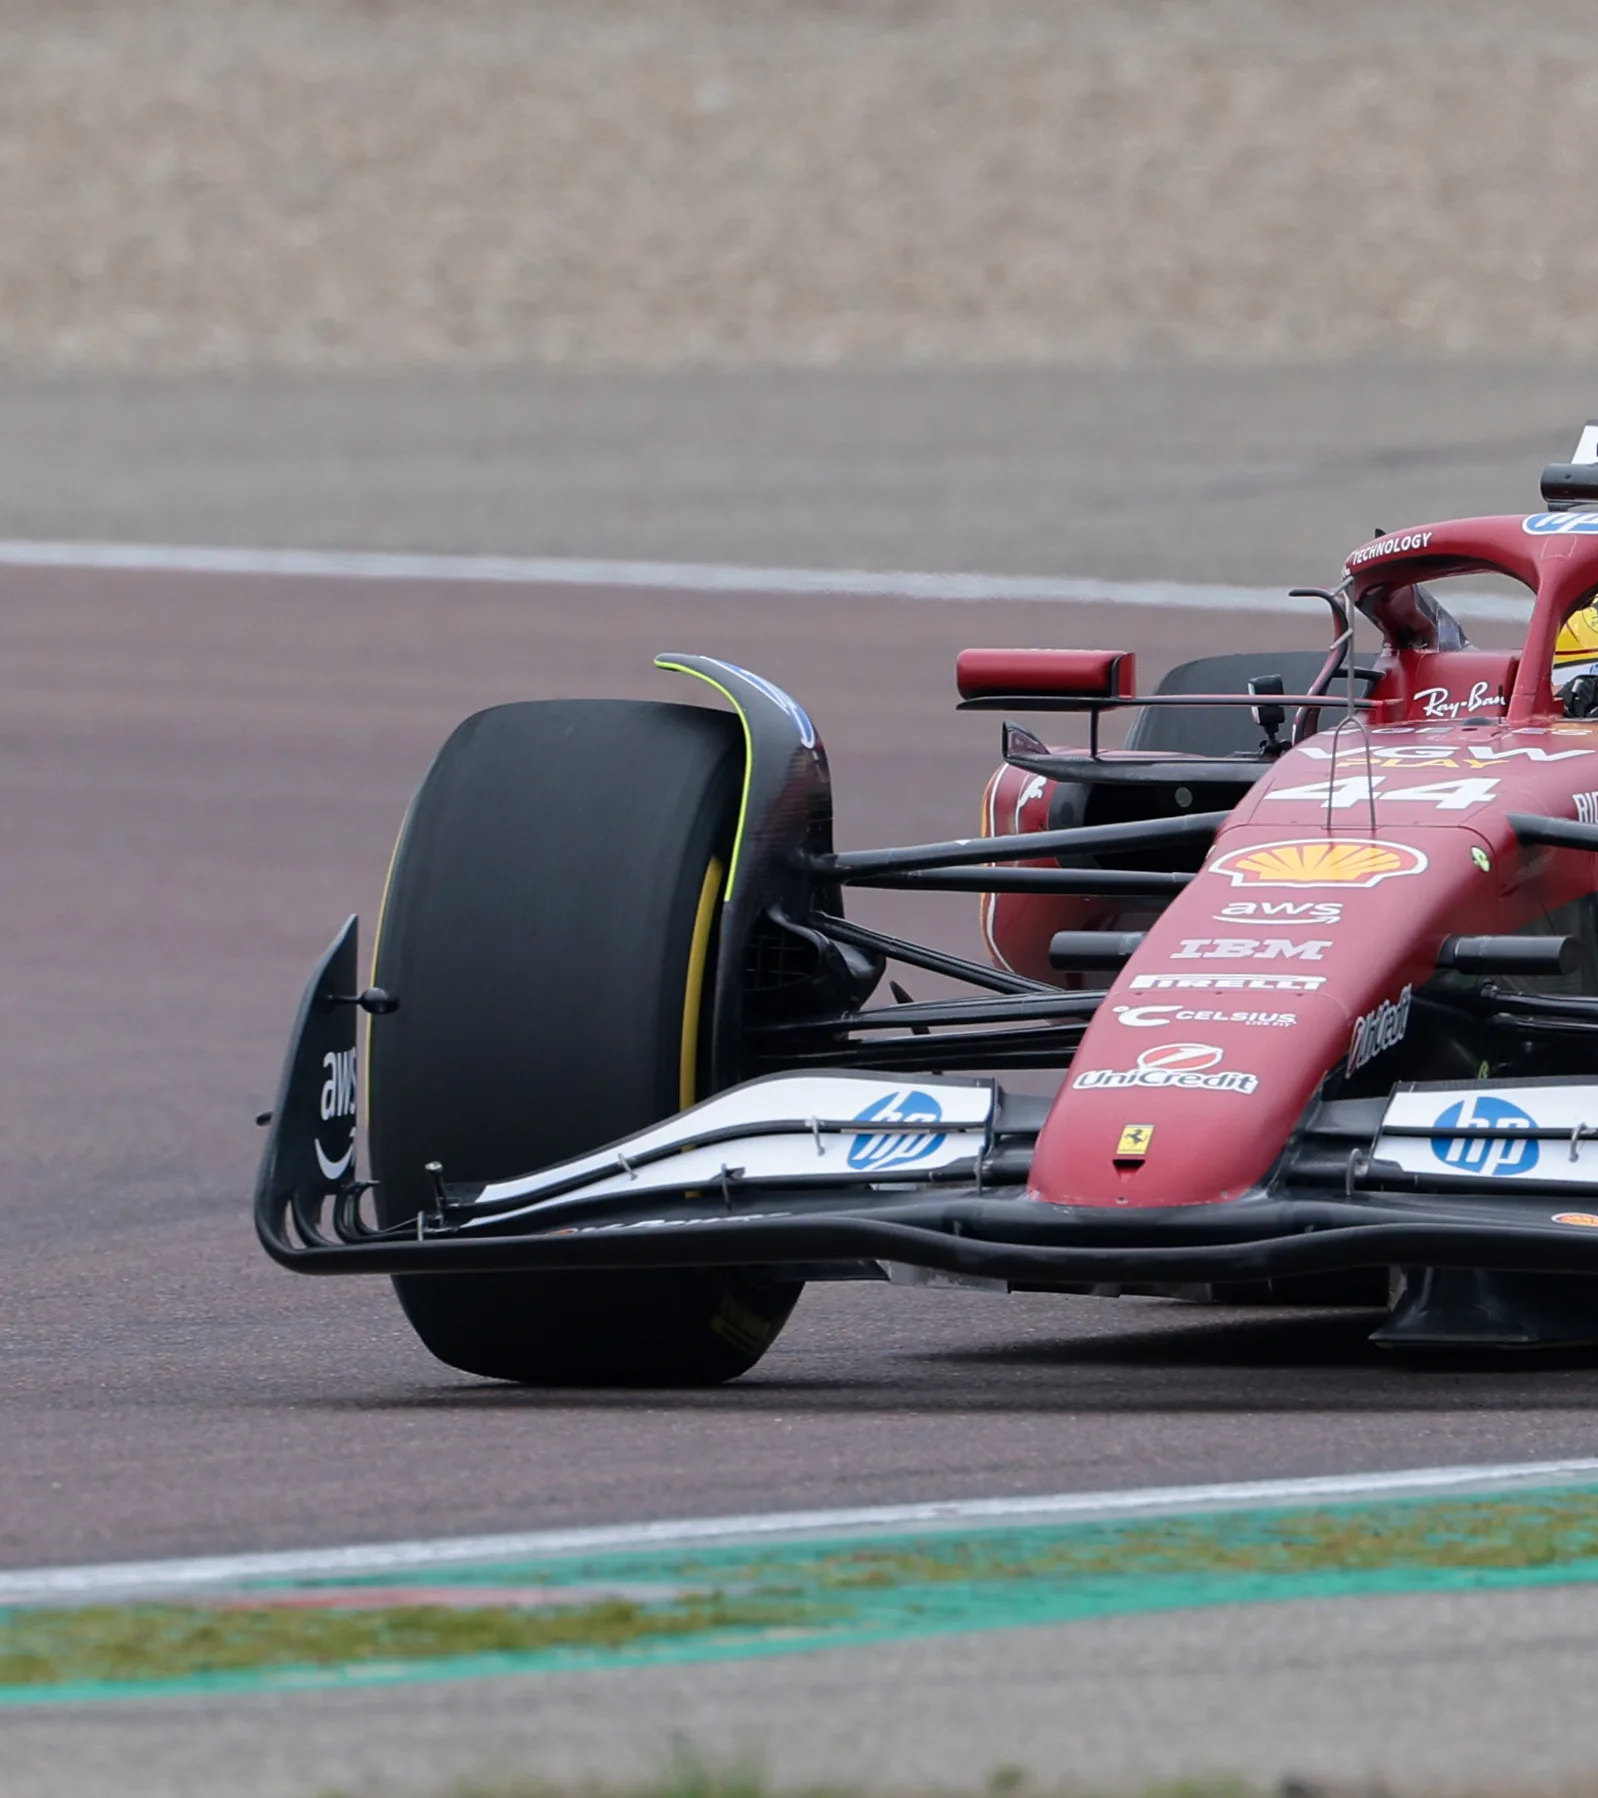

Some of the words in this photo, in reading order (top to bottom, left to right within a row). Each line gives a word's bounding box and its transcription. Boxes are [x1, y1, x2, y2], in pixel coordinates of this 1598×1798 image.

[1352, 532, 1432, 566] TECHNOLOGY
[1413, 681, 1506, 718] Ray-Ban
[1297, 745, 1596, 762] VGW
[1336, 758, 1511, 769] PLAY
[1264, 776, 1501, 809] 44
[1220, 902, 1344, 917] aws
[1170, 938, 1334, 960] IBM
[1129, 973, 1327, 990] PIRELLI
[1175, 1010, 1297, 1023] CELSIUS
[1074, 1069, 1258, 1093] UniCredit
[1445, 1097, 1531, 1176] hp
